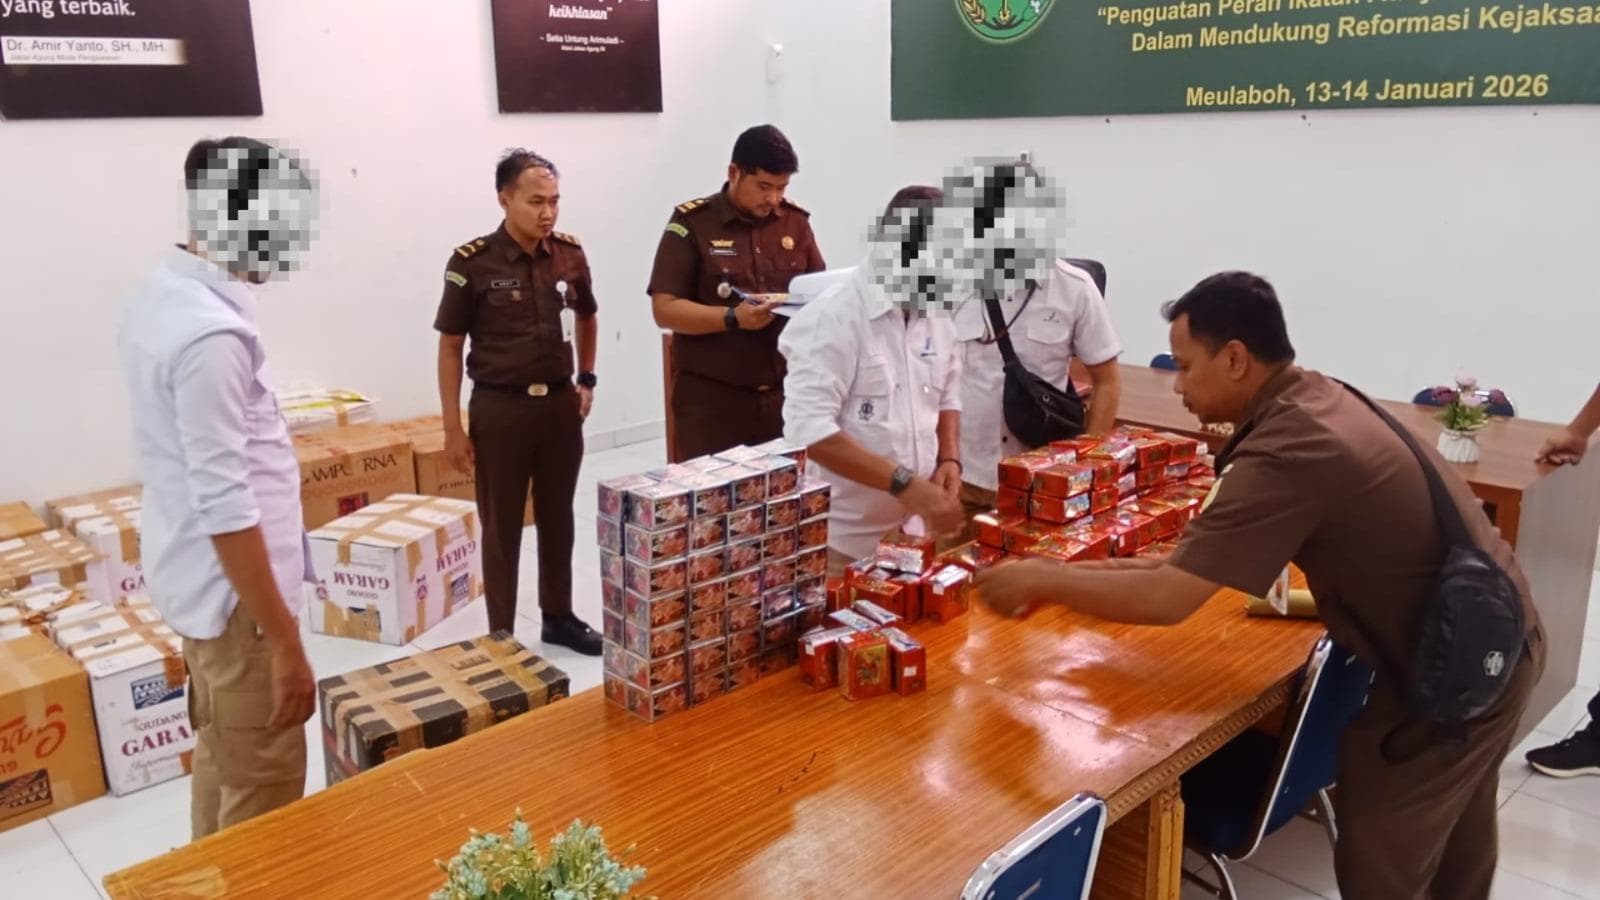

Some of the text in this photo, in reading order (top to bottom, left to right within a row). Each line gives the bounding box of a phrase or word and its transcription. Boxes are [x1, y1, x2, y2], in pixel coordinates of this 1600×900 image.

[2, 0, 136, 18] yang terbaik.
[1218, 0, 1282, 15] Peran
[1131, 27, 1194, 52] Dalam
[1199, 21, 1331, 48] Mendukung
[1337, 8, 1470, 38] Reformasi
[6, 39, 27, 51] Dr.
[31, 39, 62, 51] Amir
[65, 40, 108, 53] Yanto,
[1185, 74, 1550, 107] Meulaboh, 13-14 Januari 2026
[334, 571, 390, 591] GARAM
[121, 725, 194, 757] GARA
